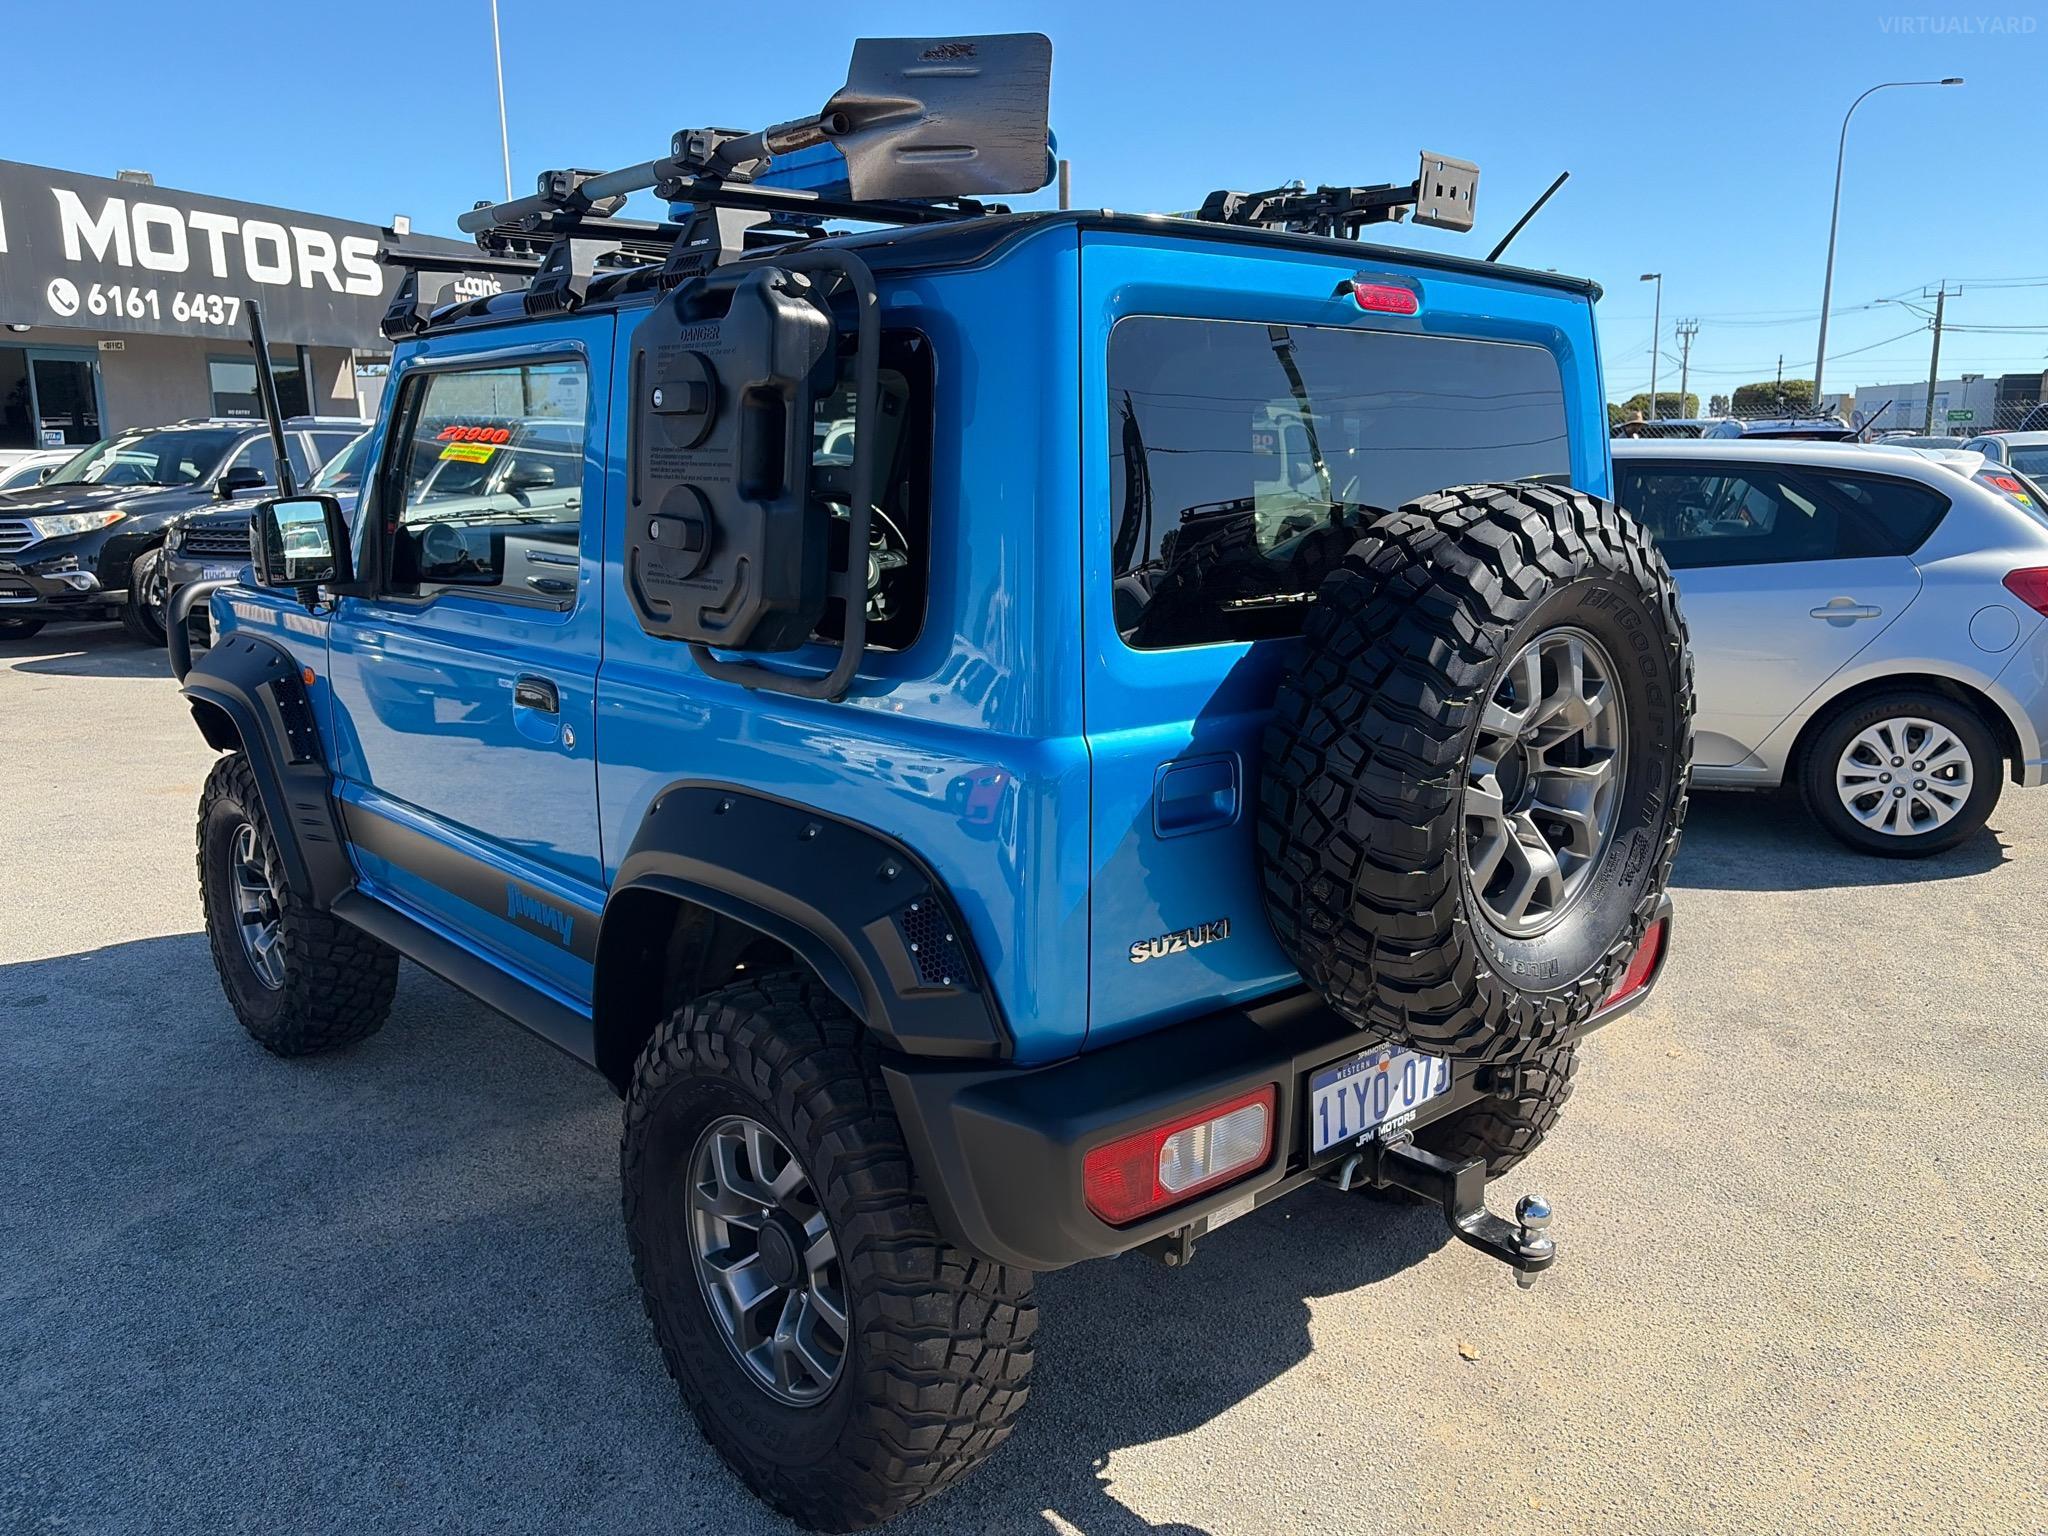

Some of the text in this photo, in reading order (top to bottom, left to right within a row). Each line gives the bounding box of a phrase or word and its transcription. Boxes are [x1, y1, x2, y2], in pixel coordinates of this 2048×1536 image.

[51, 187, 383, 297] MOTORS
[88, 283, 240, 327] 6161 6437
[681, 325, 720, 342] DANGER
[437, 426, 509, 443] 26990
[1129, 918, 1231, 963] SUZUKI
[1336, 1059, 1371, 1080] WESTERN
[1355, 1129, 1375, 1148] JPM
[1378, 1109, 1417, 1137] MOTORS
